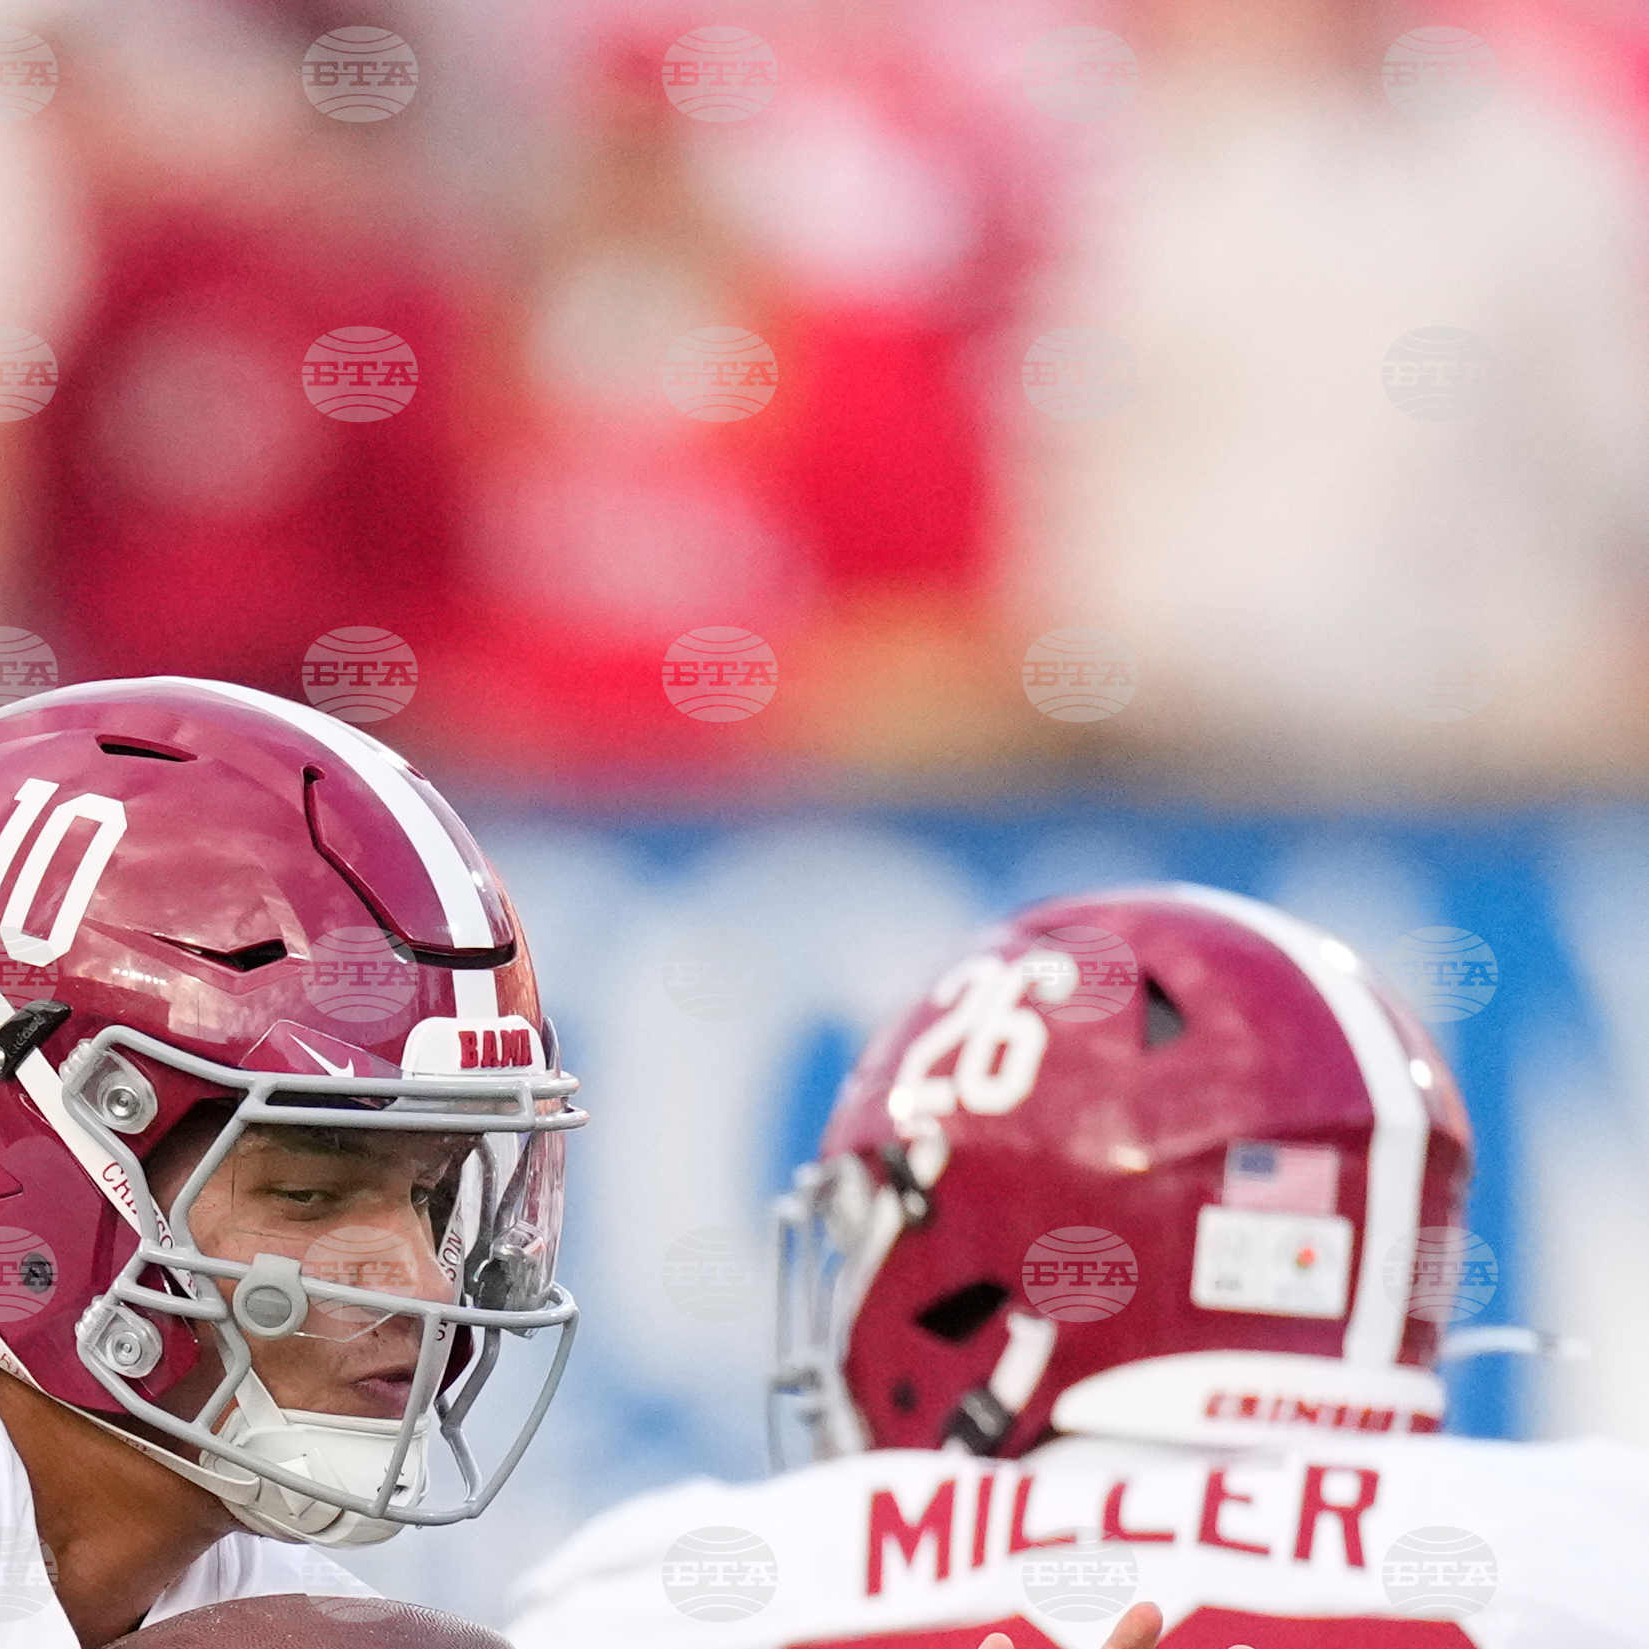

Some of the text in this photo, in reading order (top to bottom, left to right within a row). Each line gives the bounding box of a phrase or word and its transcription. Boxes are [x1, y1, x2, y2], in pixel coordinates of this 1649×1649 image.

[458, 1029, 533, 1069] BAMA
[888, 950, 1081, 1114] 26
[866, 1464, 1380, 1597] MILLER
